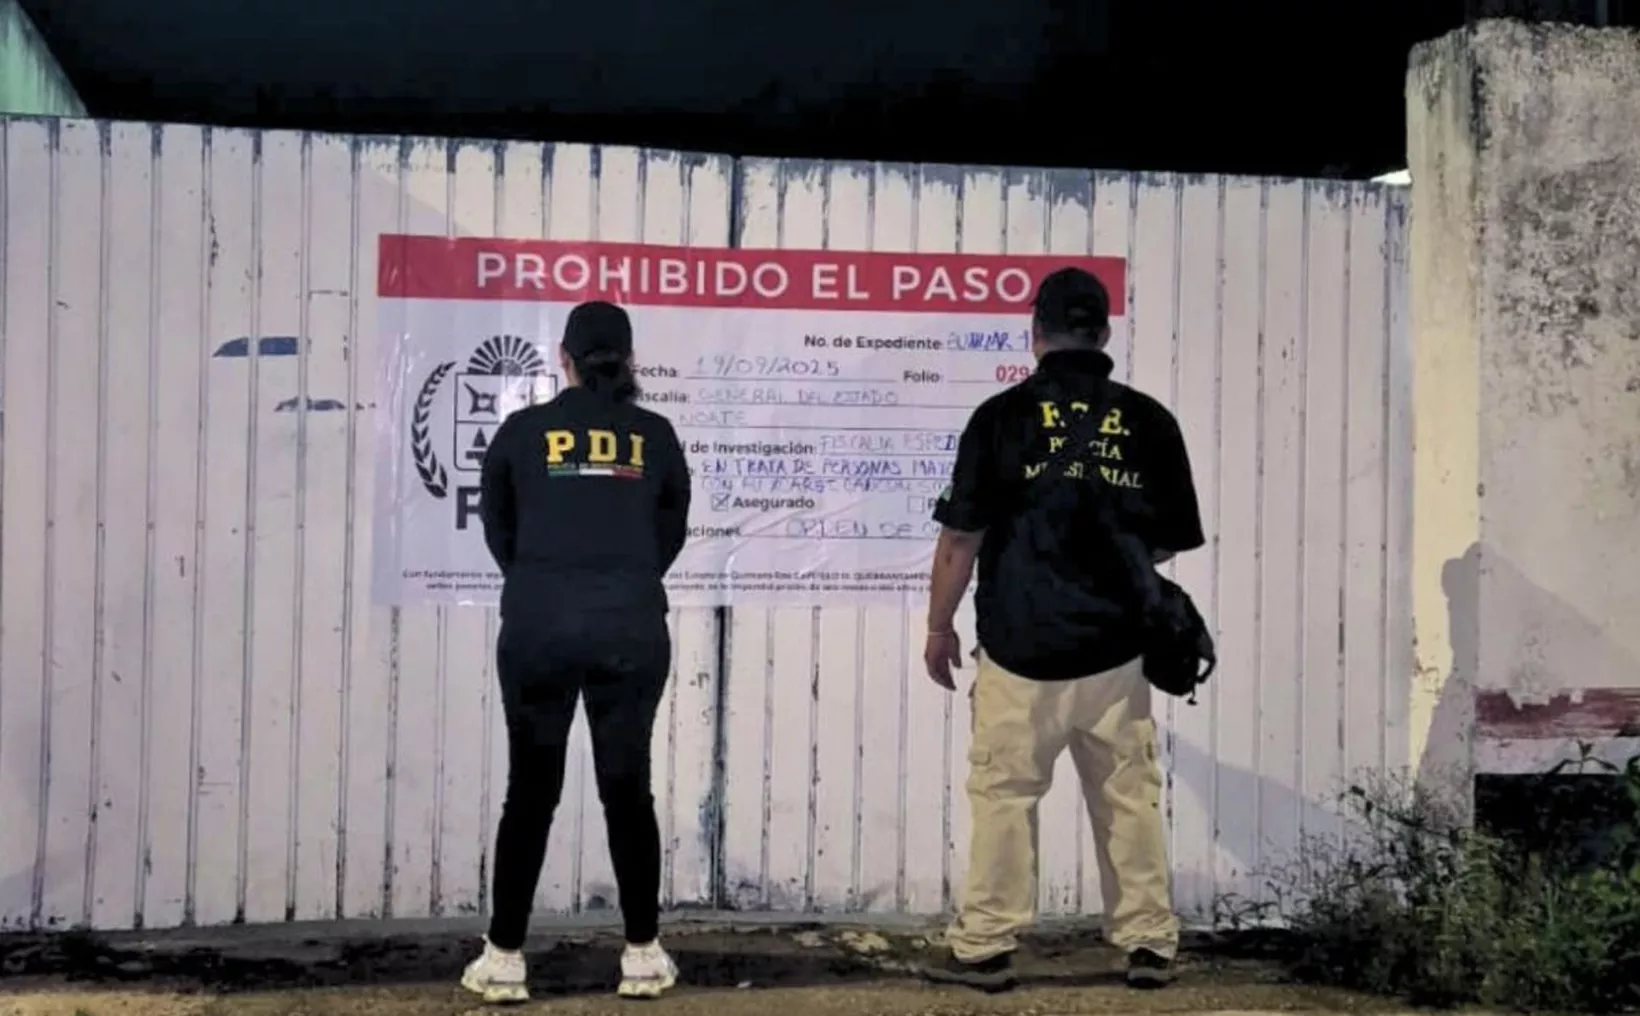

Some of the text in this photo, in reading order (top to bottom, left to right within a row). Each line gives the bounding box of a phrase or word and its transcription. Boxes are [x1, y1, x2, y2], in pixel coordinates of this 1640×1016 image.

[477, 252, 1032, 302] PROHIBIDO EL PASO
[833, 335, 853, 350] de
[996, 364, 1030, 383] 029
[545, 428, 645, 466] PDI
[691, 441, 709, 453] de
[732, 496, 815, 511] Asegurado
